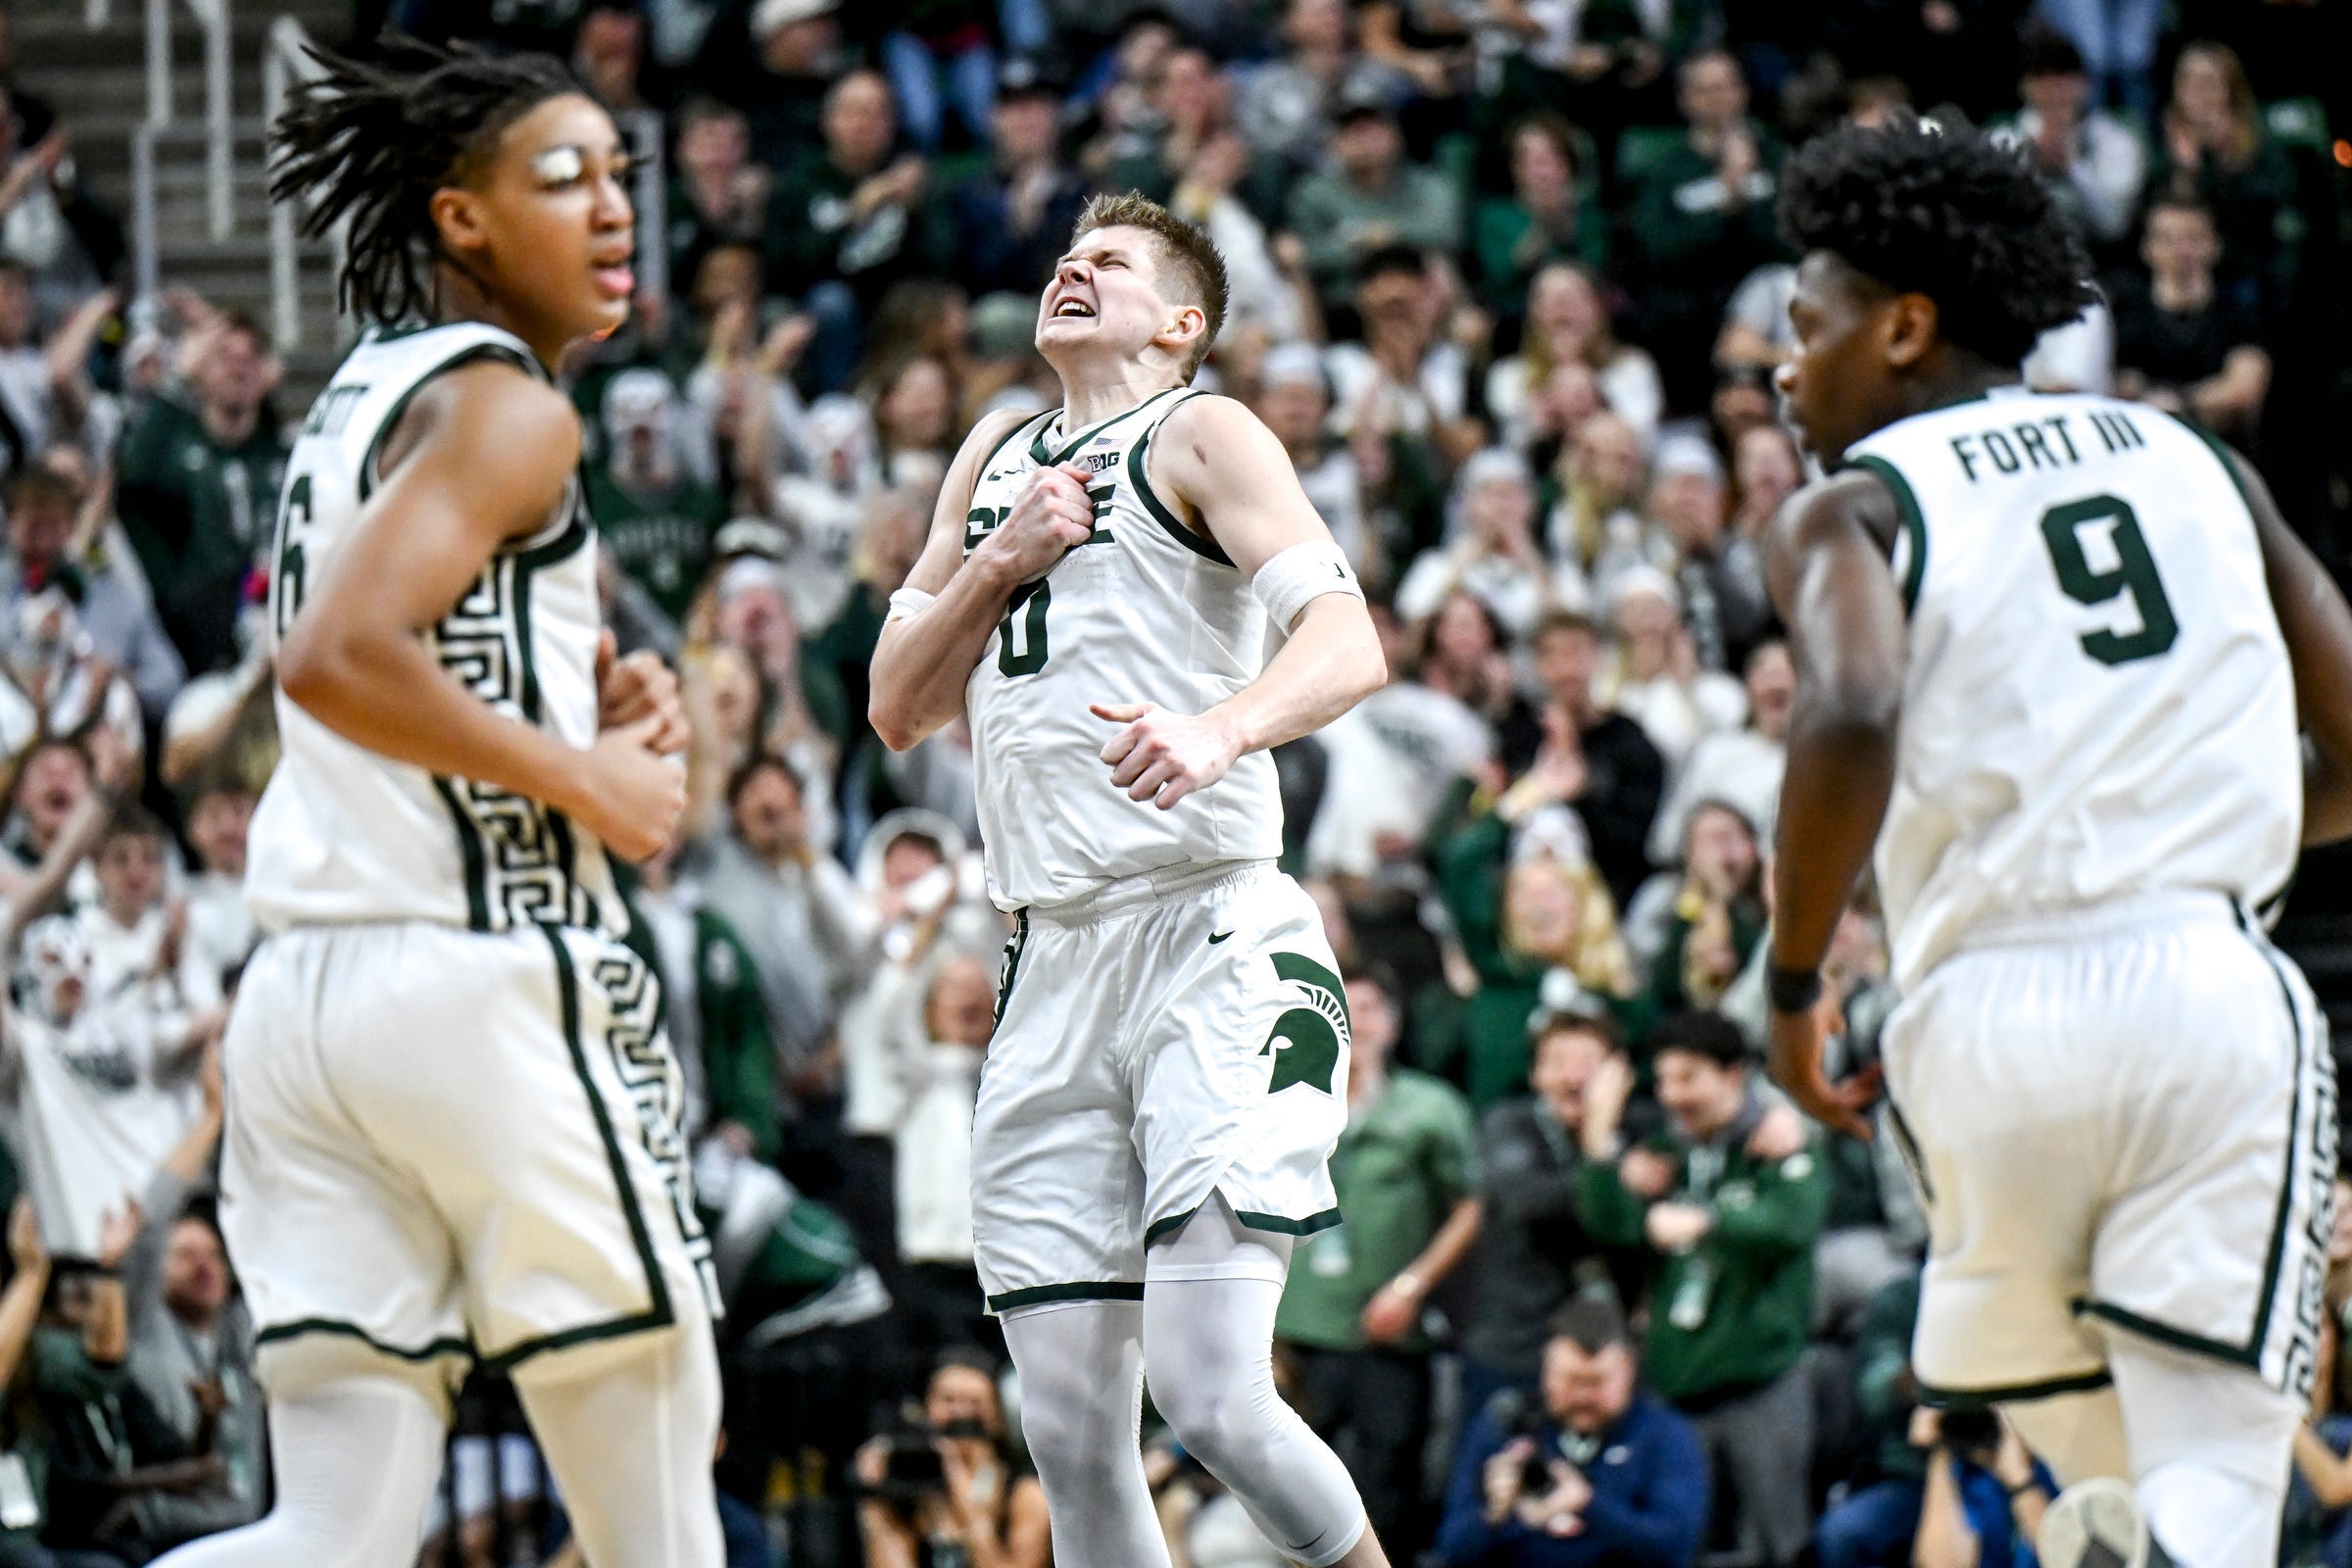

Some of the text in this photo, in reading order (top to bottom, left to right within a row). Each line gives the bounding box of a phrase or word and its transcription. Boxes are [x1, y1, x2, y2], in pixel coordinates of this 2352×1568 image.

[1949, 411, 2143, 481] FORT III
[277, 476, 312, 639] 6
[2040, 494, 2179, 665] 9
[999, 576, 1052, 678] 0
